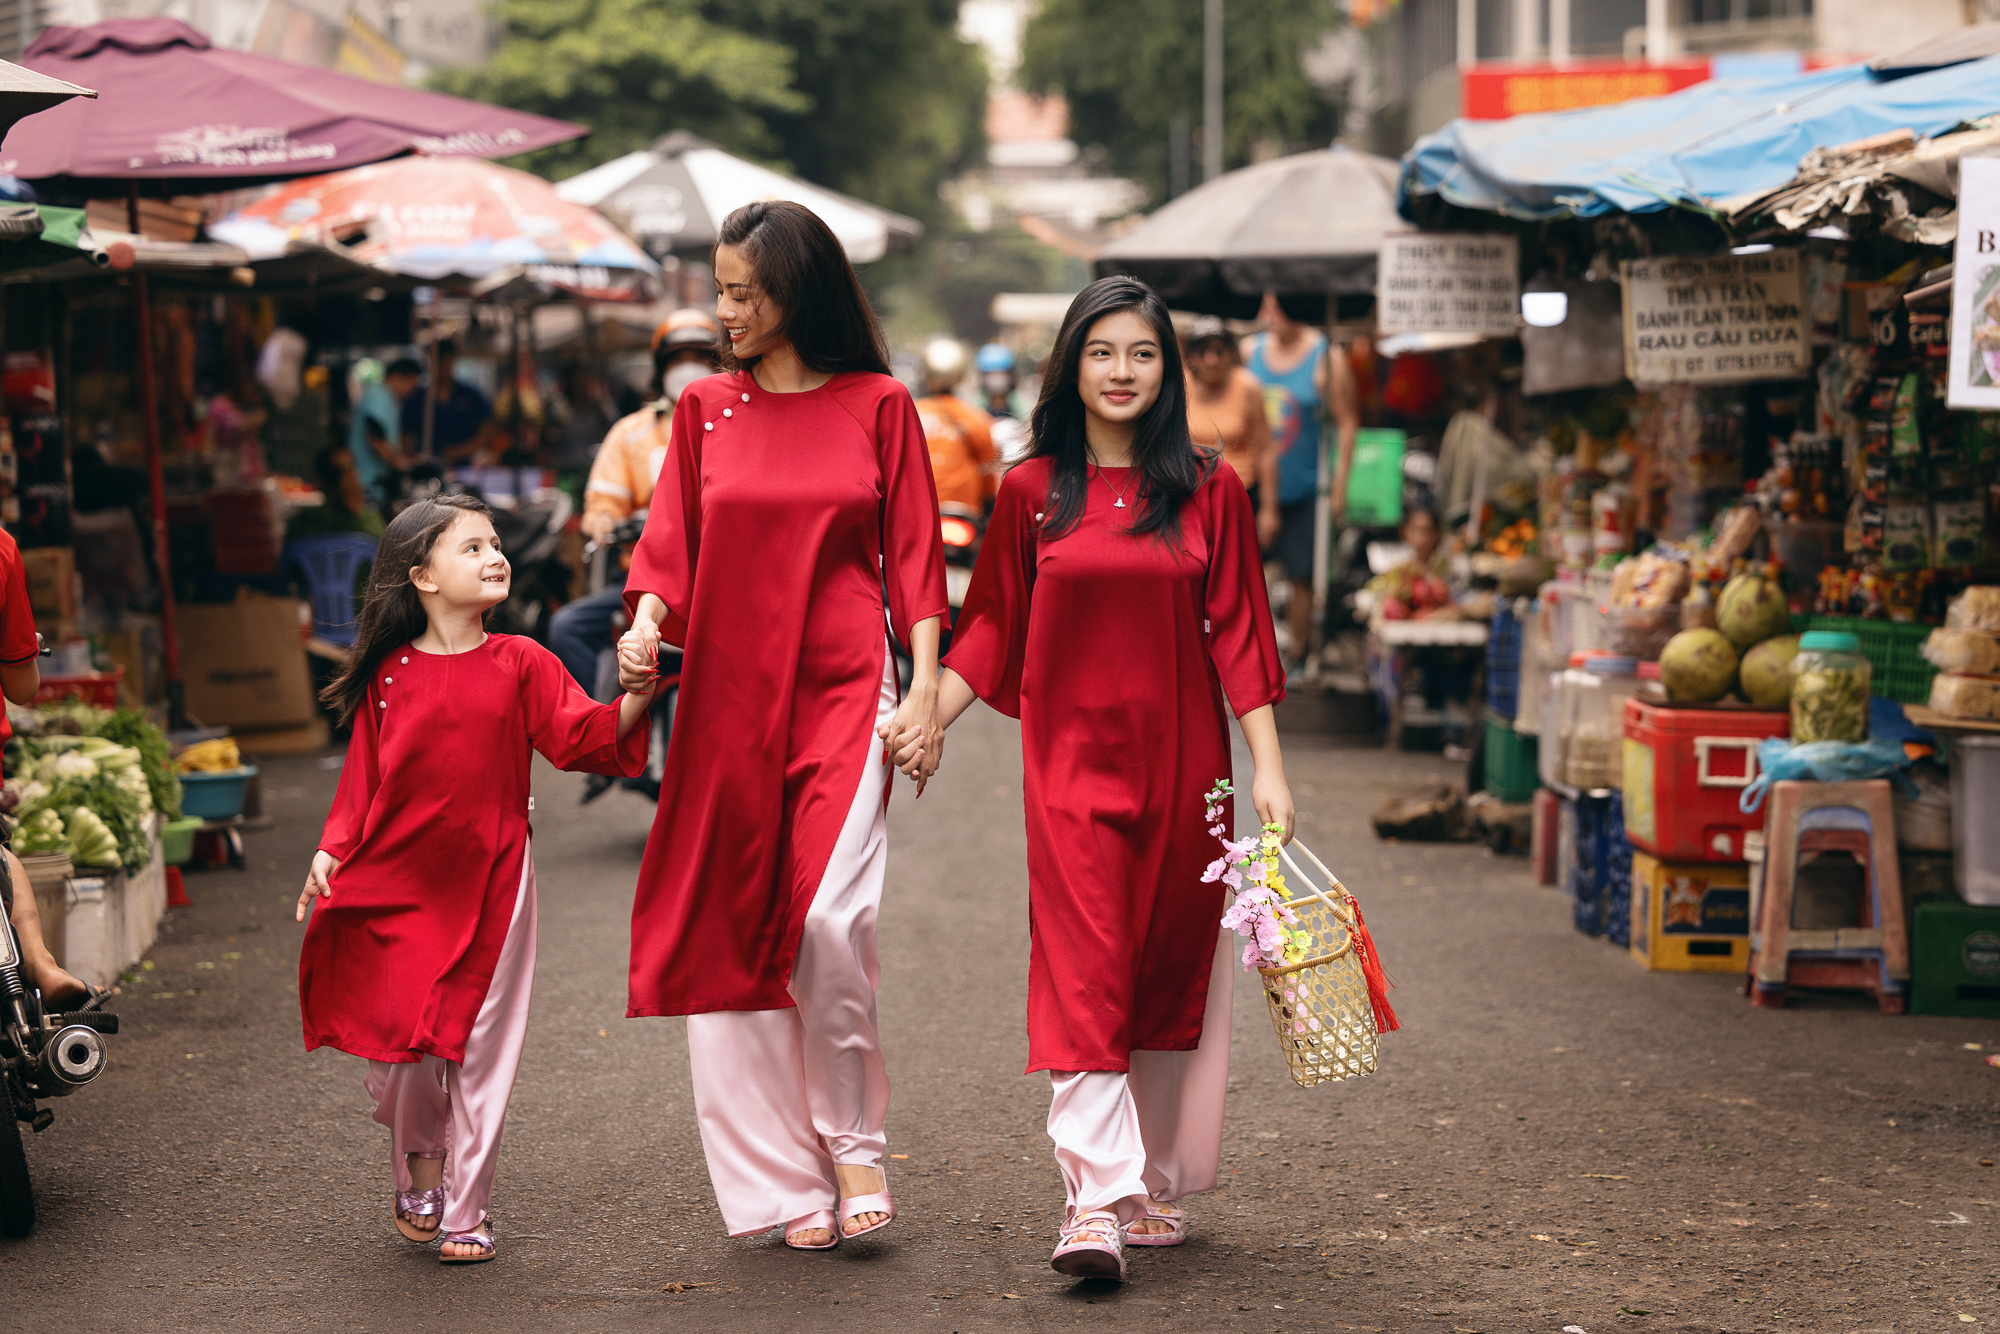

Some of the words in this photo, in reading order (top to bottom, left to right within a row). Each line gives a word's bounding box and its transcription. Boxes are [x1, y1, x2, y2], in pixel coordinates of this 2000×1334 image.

[1637, 308, 1678, 330] BÁNH
[1683, 308, 1723, 327] FLAN
[1638, 333, 1687, 351] RAU
[1693, 329, 1742, 348] CÂU
[1748, 325, 1799, 345] DỪA
